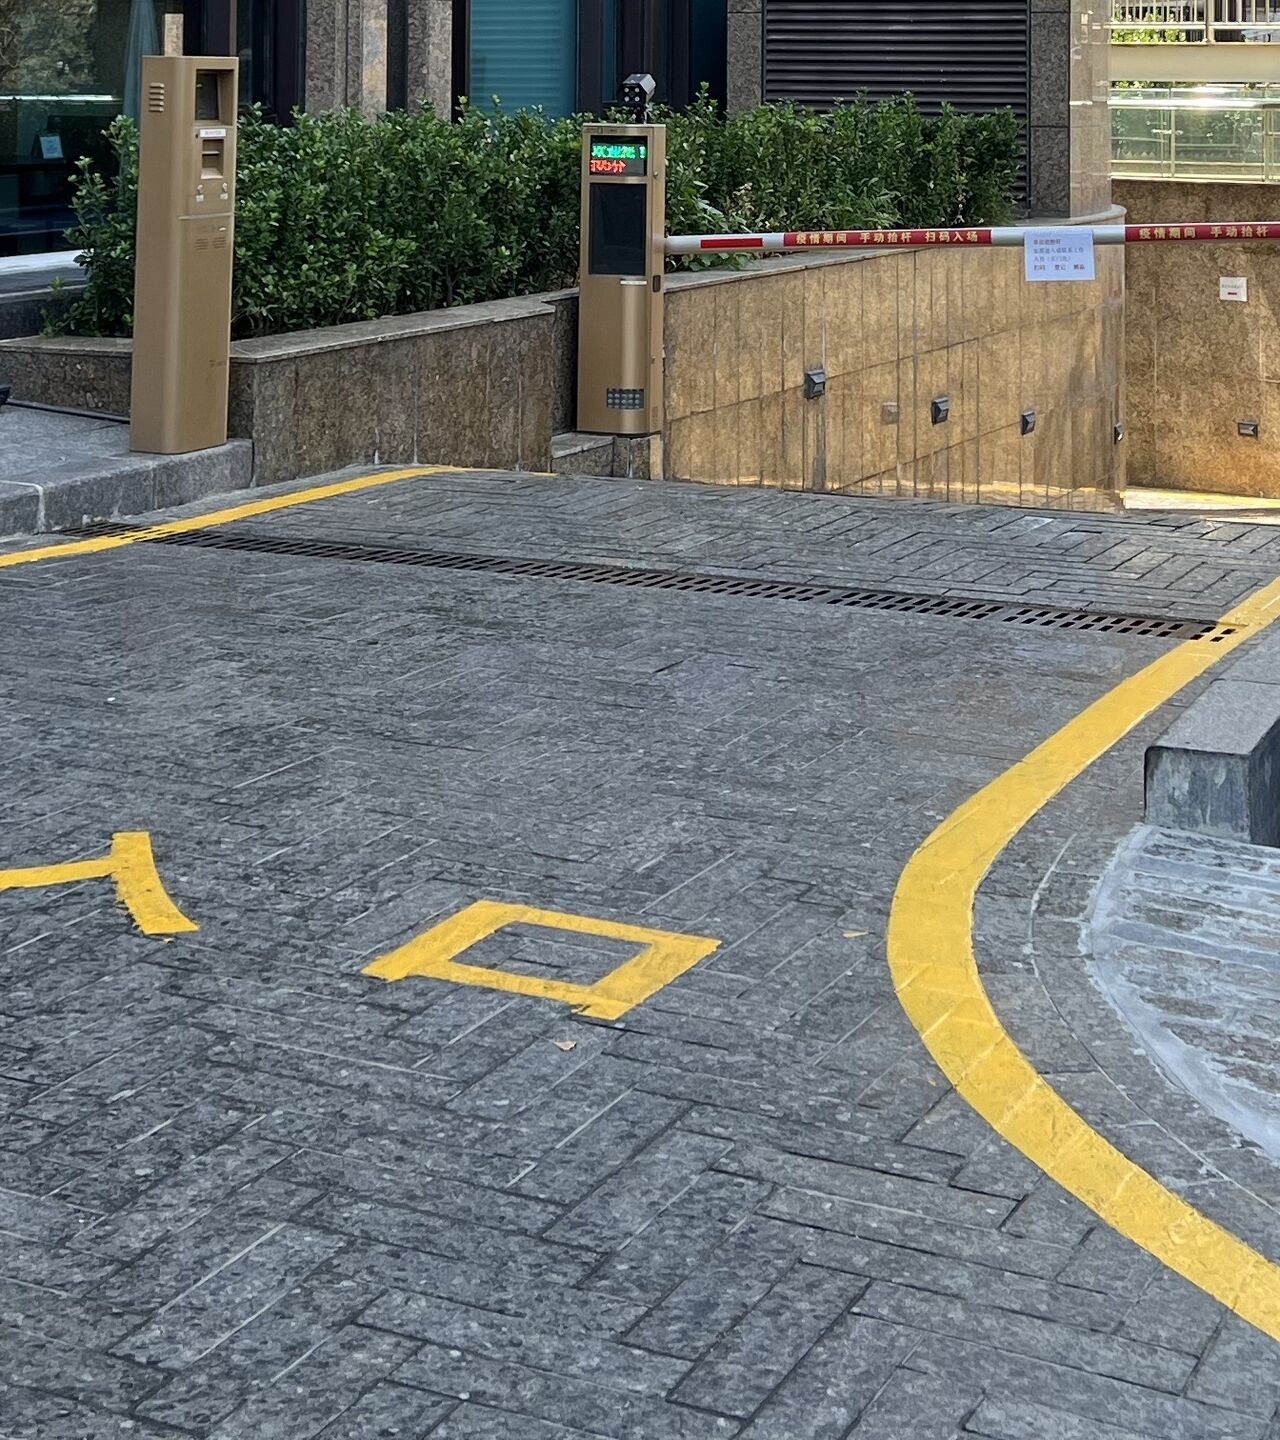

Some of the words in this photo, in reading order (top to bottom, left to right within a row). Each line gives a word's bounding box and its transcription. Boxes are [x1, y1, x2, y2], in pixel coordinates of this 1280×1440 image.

[796, 232, 848, 245] 疫情期间
[925, 231, 979, 243] 扫码入场
[1138, 226, 1196, 240] 疫情期间
